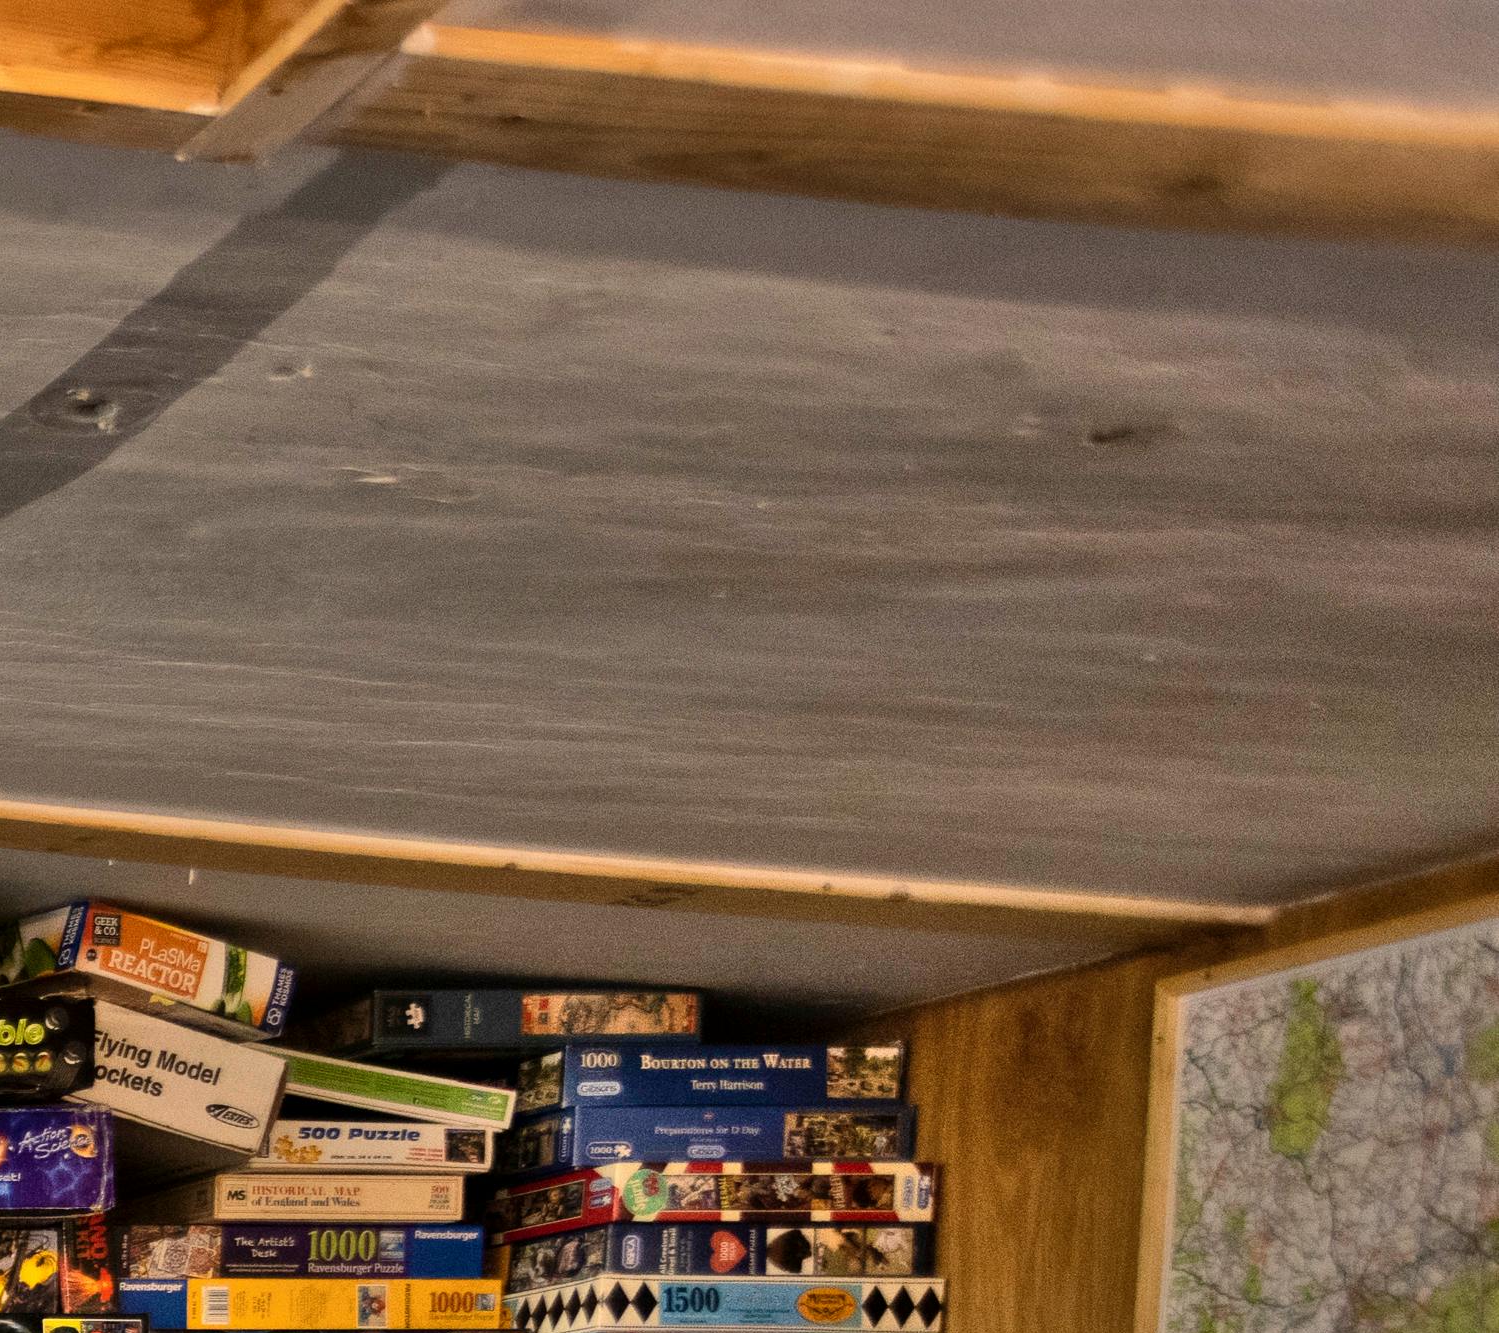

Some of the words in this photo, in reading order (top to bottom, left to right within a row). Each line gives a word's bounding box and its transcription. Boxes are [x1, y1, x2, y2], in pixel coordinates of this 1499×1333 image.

[94, 916, 118, 927] GEEK
[94, 927, 102, 935] &
[108, 949, 196, 994] REACTOR
[272, 966, 288, 1006] THAMES
[157, 1048, 221, 1086] Model
[580, 1052, 619, 1069] 1000
[639, 1054, 707, 1071] BOURTON
[710, 1058, 730, 1070] ON
[734, 1058, 760, 1070] THE
[762, 1054, 812, 1070] WATER
[93, 1065, 163, 1097] ockets
[690, 1079, 717, 1094] Terry
[719, 1079, 765, 1091] Harrison
[18, 1127, 68, 1153] Action
[298, 1127, 340, 1140] 500
[348, 1127, 421, 1141] Puzzle
[588, 1144, 612, 1155] 1000
[226, 1189, 246, 1201] MS
[251, 1185, 325, 1197] HISTORICAL
[333, 1185, 361, 1196] MAP
[234, 1236, 255, 1248] The
[258, 1236, 295, 1248] Artist's
[307, 1229, 377, 1262] 1000
[414, 1229, 479, 1242] Ravensburger
[250, 1248, 278, 1258] Desk
[307, 1262, 372, 1276] Ravensburger
[374, 1262, 404, 1274] Puzzle
[118, 1282, 183, 1293] Ravensburger
[428, 1291, 474, 1314] 1000
[662, 1286, 720, 1313] 1500
